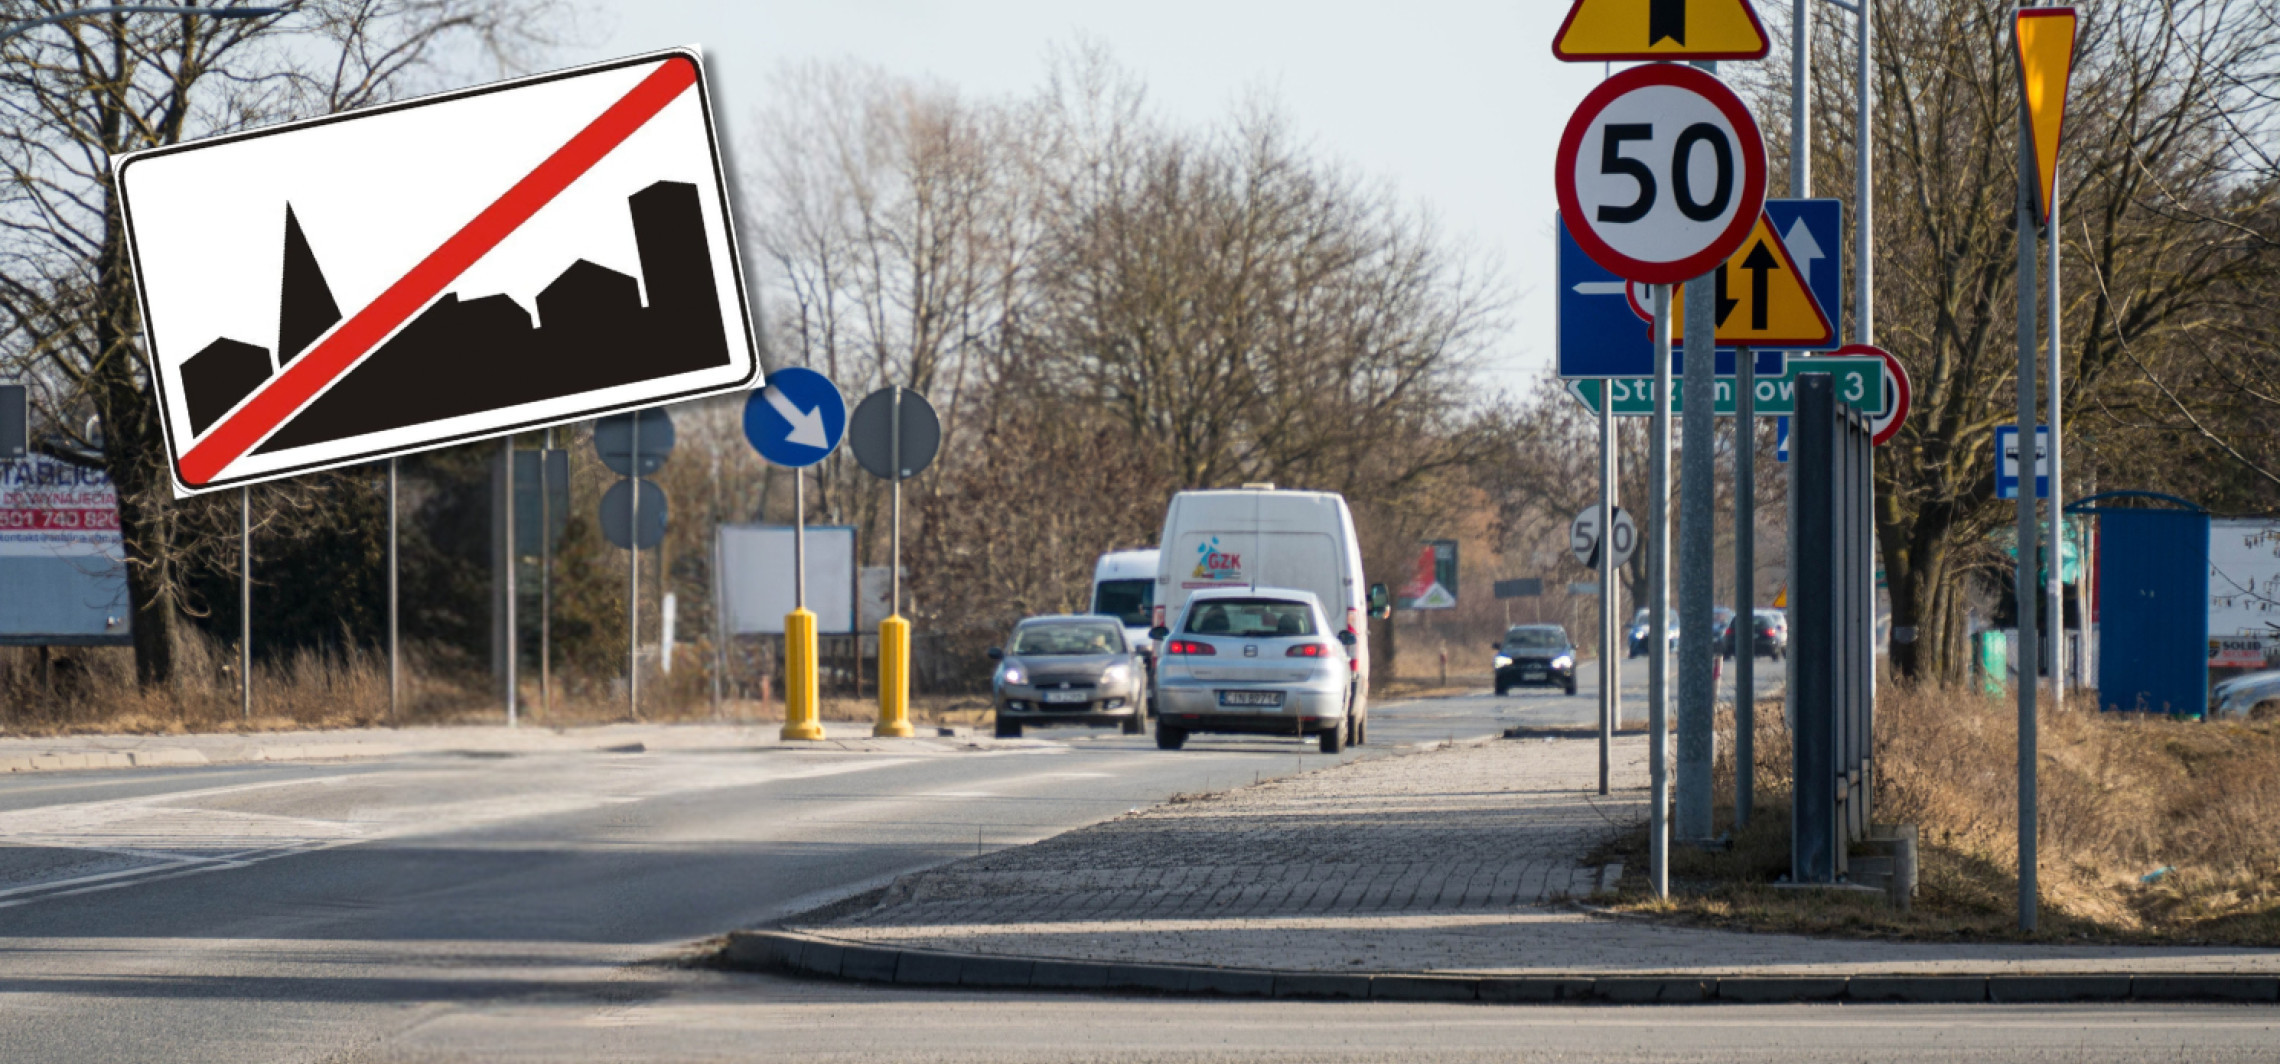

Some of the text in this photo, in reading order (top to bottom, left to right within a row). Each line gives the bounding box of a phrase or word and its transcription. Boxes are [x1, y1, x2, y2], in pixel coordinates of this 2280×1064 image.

[1597, 122, 1734, 223] 50
[1844, 372, 1865, 400] 3
[41, 511, 79, 527] 740
[1575, 522, 1632, 553] 50
[1209, 553, 1241, 570] GZK
